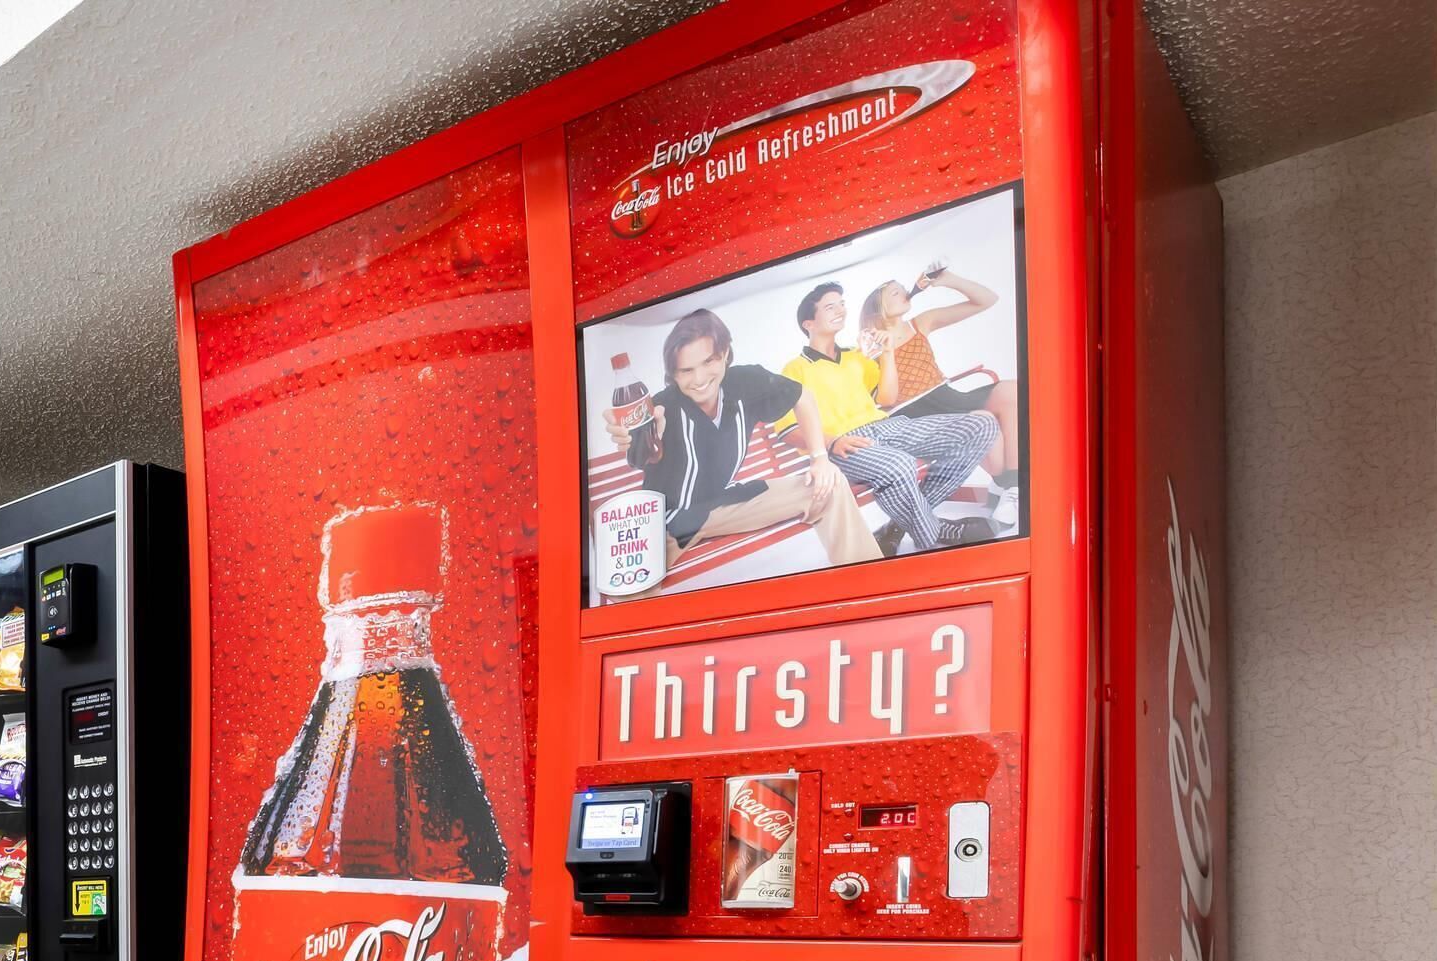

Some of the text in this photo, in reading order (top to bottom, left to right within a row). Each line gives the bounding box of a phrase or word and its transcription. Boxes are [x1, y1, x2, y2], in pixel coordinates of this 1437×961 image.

[651, 126, 719, 171] Enjoy
[666, 88, 898, 200] Ice Cold Refreshment
[601, 500, 659, 524] BALANCE
[609, 516, 650, 532] WHAT YOU
[618, 527, 640, 542] EAT
[611, 539, 649, 557] DRINK
[615, 553, 643, 569] & DO
[613, 623, 966, 743] Thirsty?
[779, 865, 792, 874] 240
[305, 925, 348, 960] Enjoy
